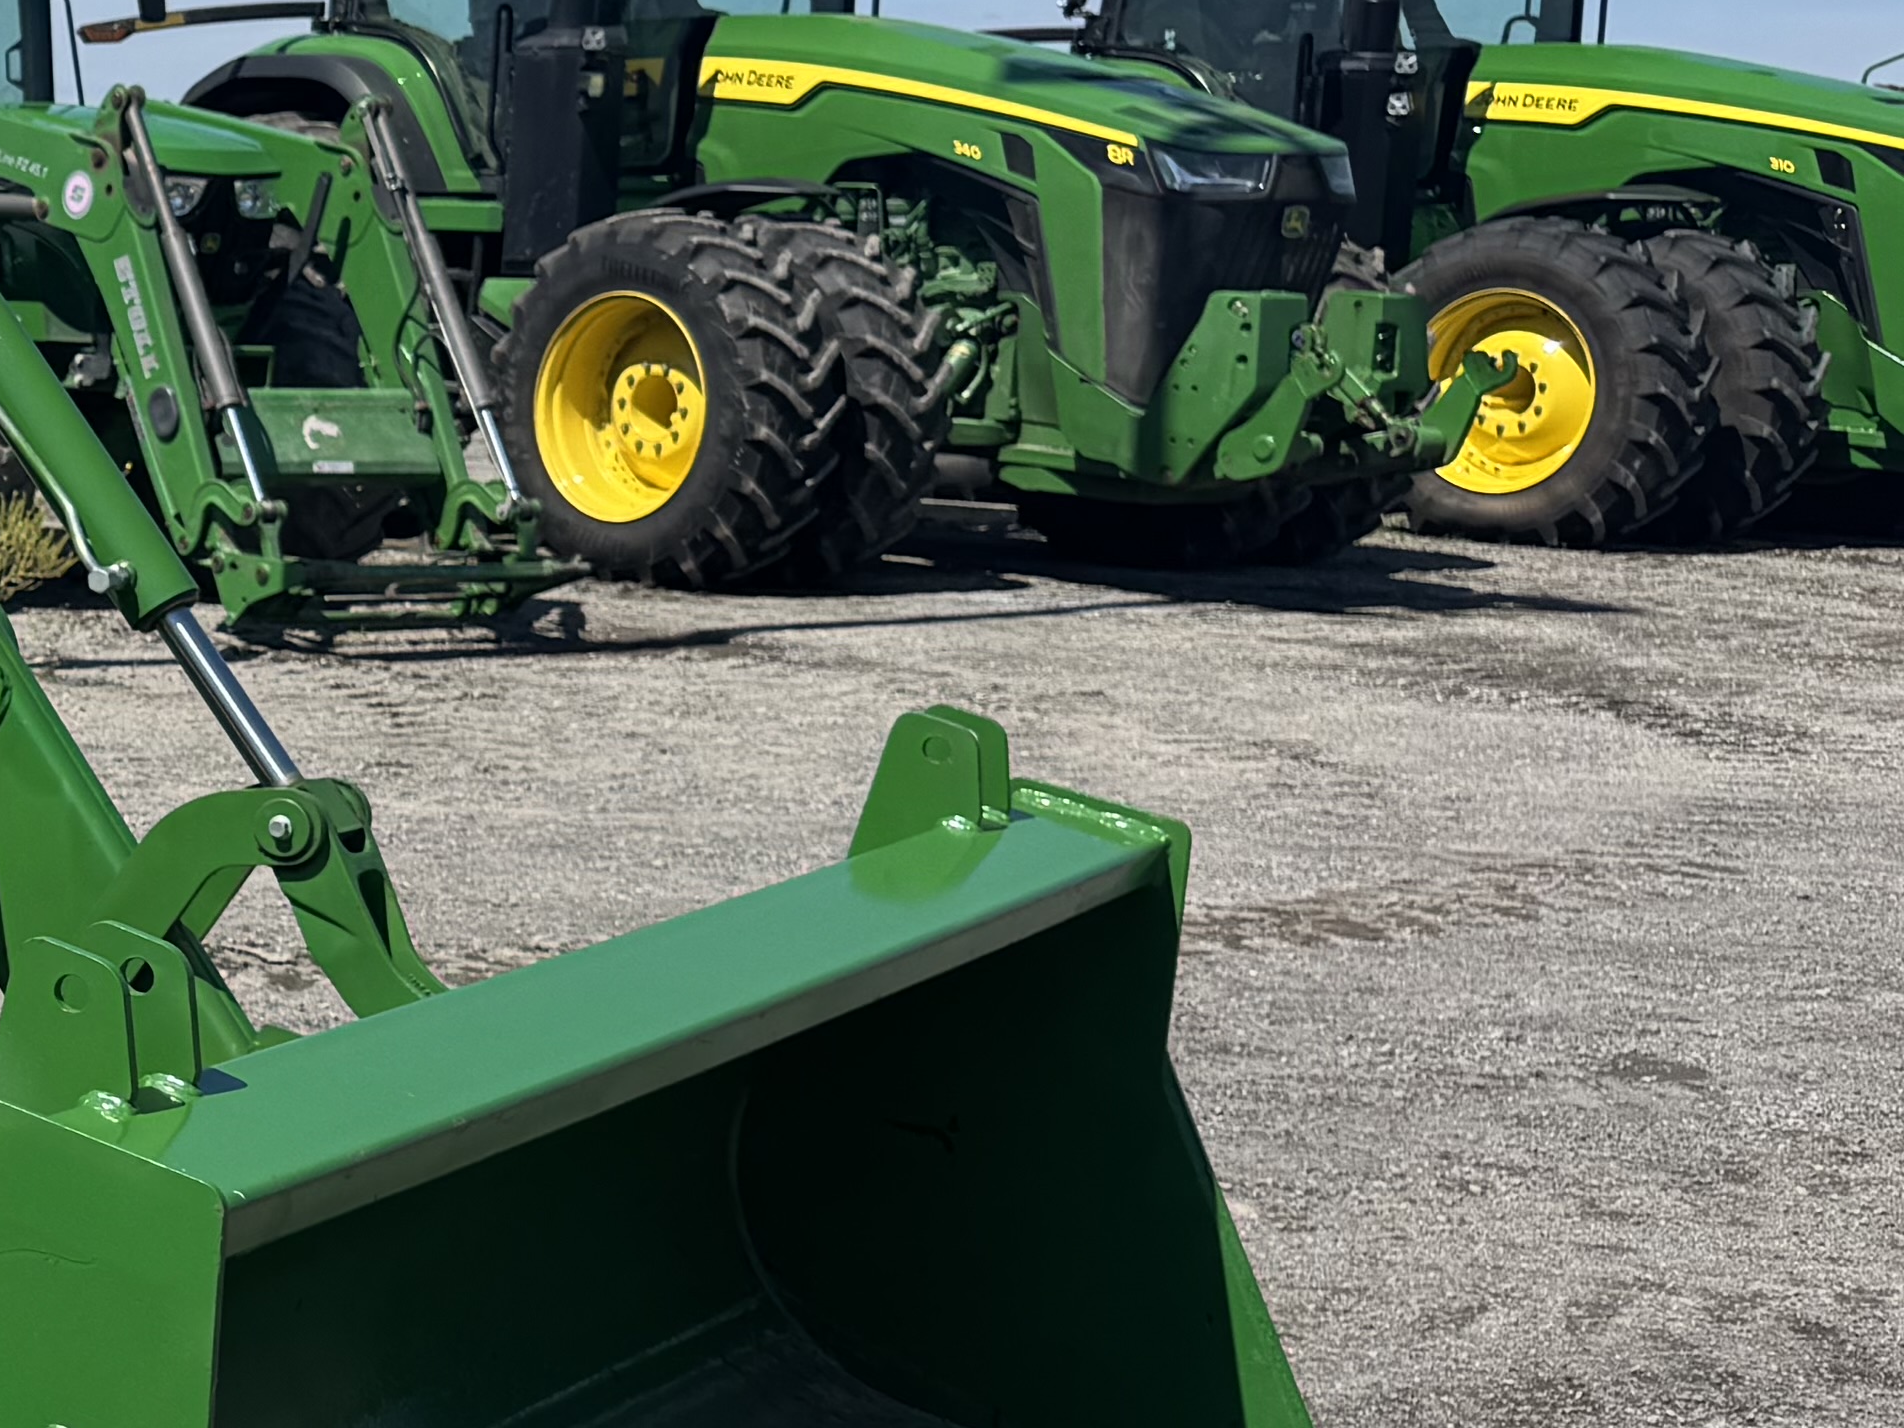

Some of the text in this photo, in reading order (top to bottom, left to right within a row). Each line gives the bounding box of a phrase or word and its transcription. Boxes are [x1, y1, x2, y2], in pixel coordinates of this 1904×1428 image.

[747, 70, 794, 89] DEERE
[1521, 93, 1579, 112] DEERE
[1106, 143, 1135, 167] 8R
[1769, 156, 1796, 174] 310
